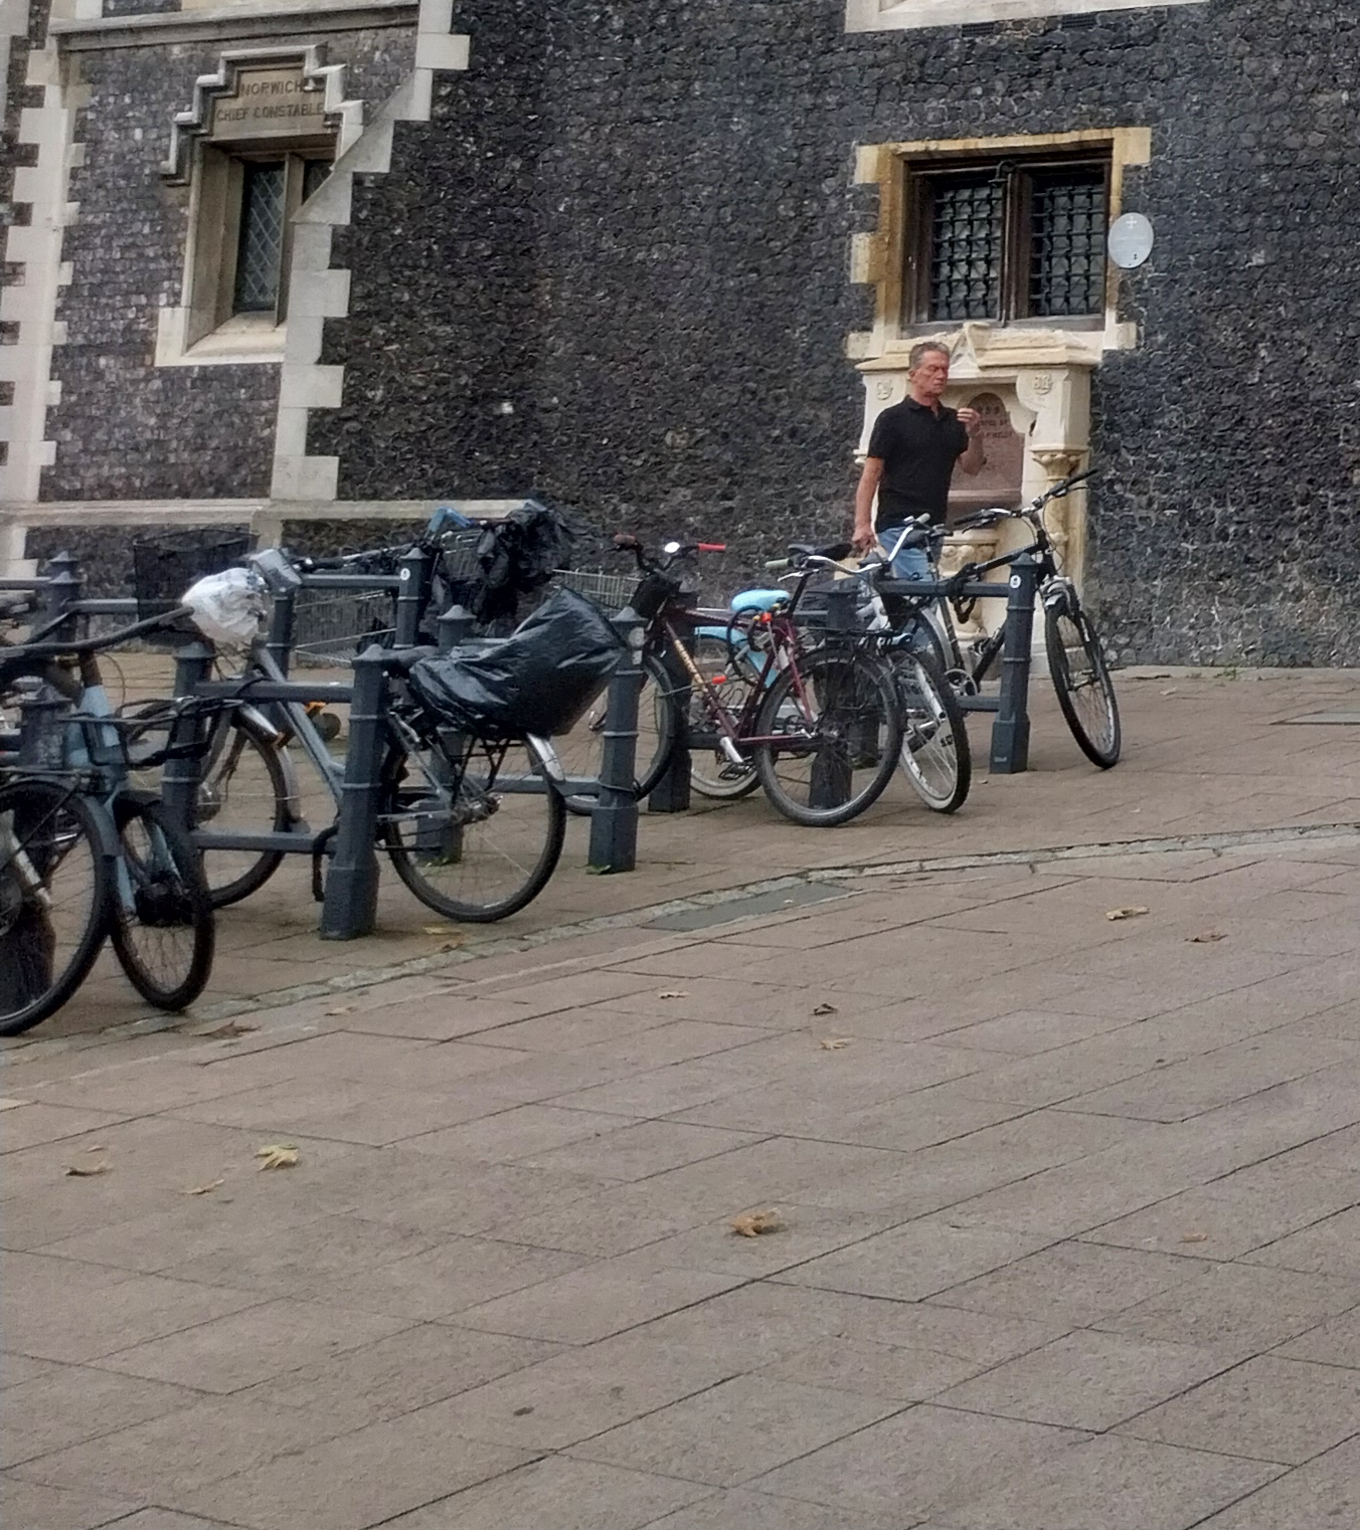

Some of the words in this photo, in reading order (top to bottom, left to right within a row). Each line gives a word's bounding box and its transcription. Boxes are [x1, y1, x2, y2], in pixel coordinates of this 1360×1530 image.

[241, 80, 304, 96] NORWICH
[216, 108, 249, 122] CHIEF
[253, 103, 324, 120] CONSTABLE
